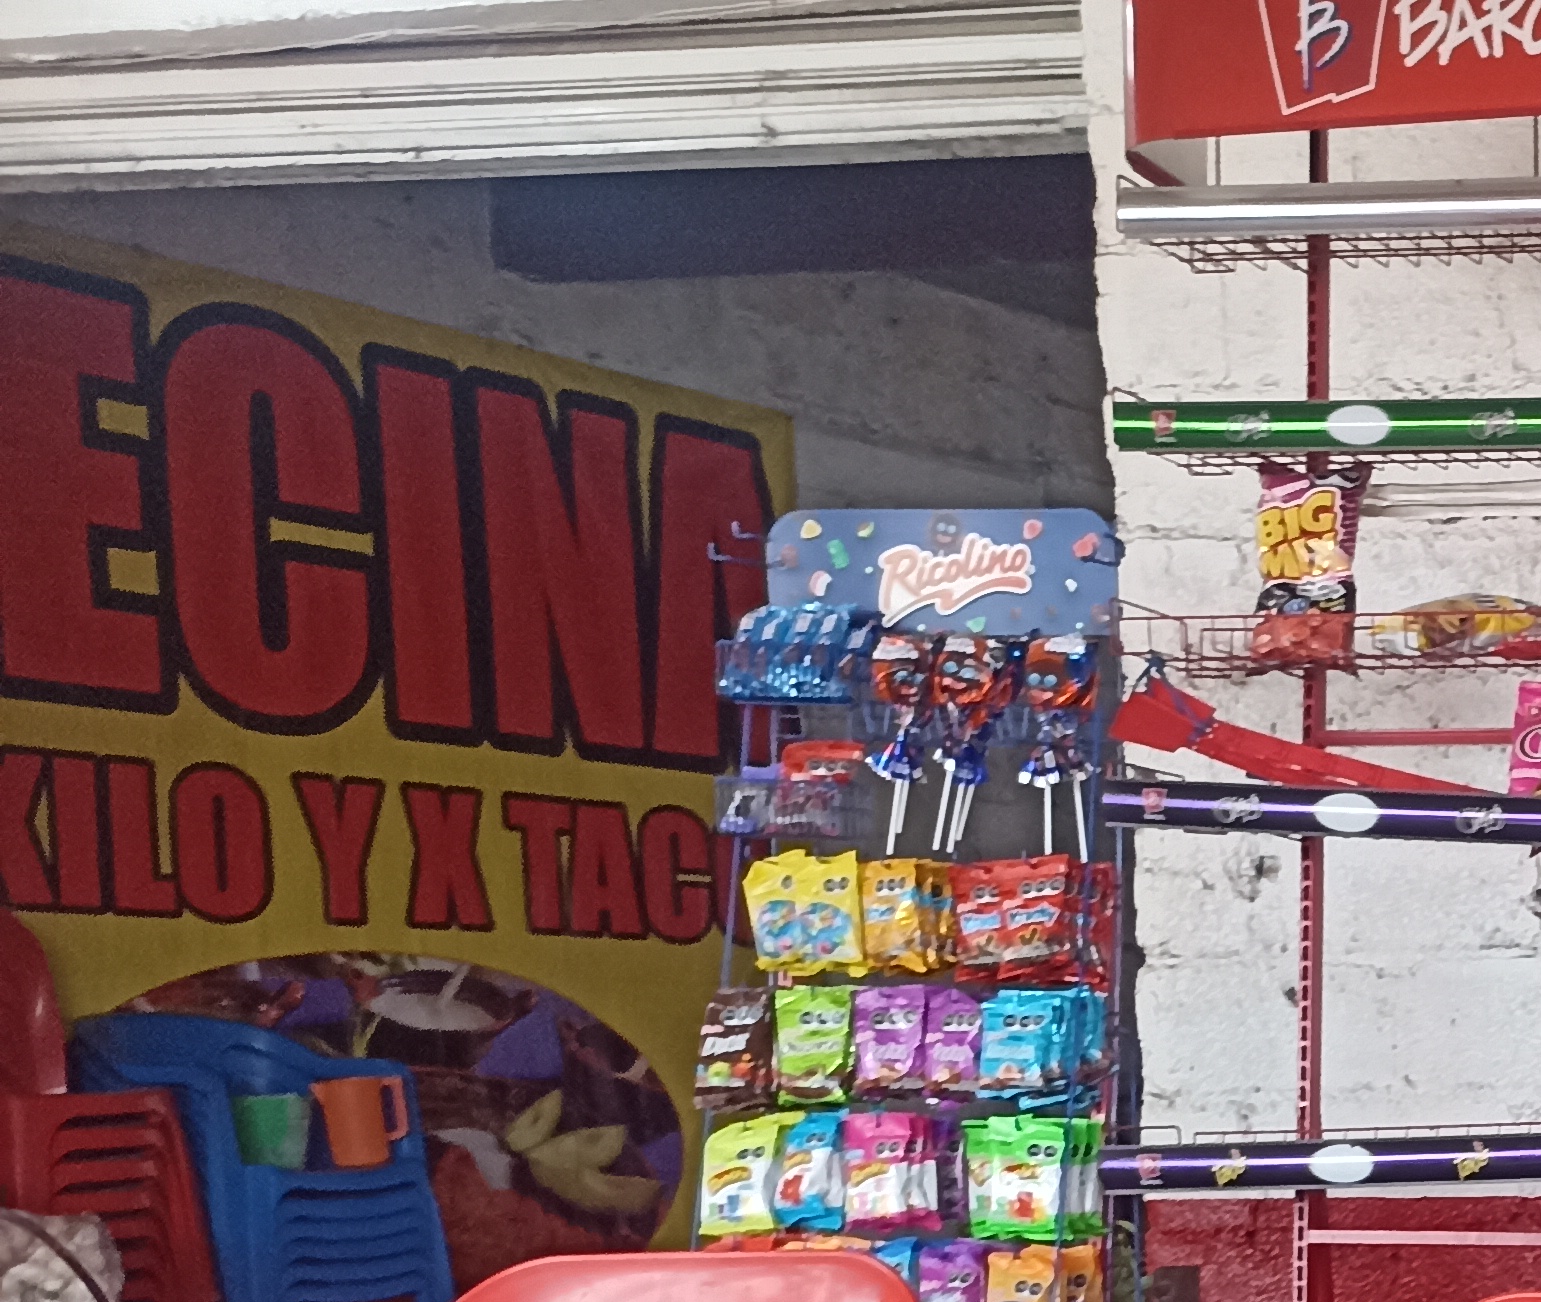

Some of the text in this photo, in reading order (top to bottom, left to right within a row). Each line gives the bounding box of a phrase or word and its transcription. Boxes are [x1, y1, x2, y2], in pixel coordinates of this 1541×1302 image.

[0, 255, 775, 775] ECINA
[1255, 490, 1336, 548] BIG
[1259, 532, 1351, 579] MIX
[879, 533, 1033, 620] Ricolino
[0, 745, 275, 925] KILO
[291, 770, 386, 927] Y
[400, 780, 496, 931] X
